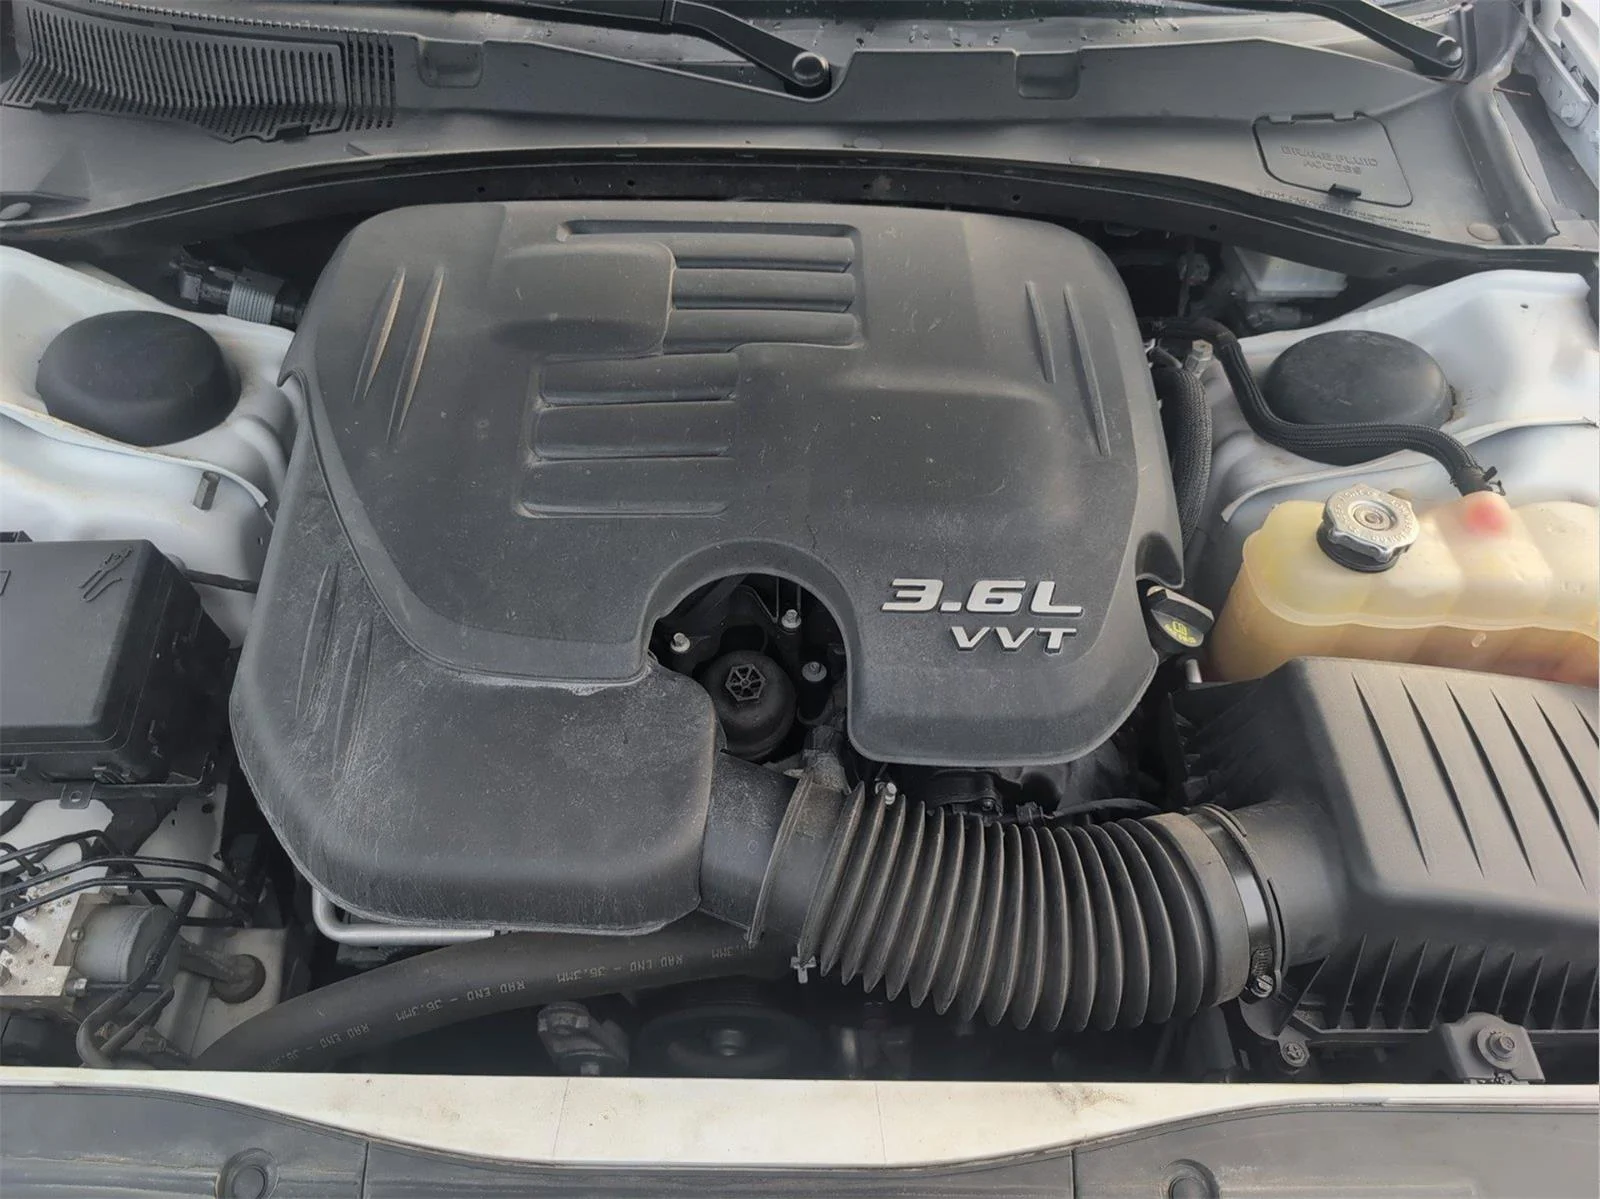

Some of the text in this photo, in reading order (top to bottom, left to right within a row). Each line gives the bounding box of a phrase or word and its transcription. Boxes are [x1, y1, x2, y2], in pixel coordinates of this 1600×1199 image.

[1280, 144, 1378, 167] BRAKE FLUID
[1303, 160, 1362, 175] ACCESS
[881, 578, 1083, 615] 3.6L
[950, 626, 1077, 653] VVT
[466, 987, 491, 1002] END
[499, 980, 526, 994] RAD
